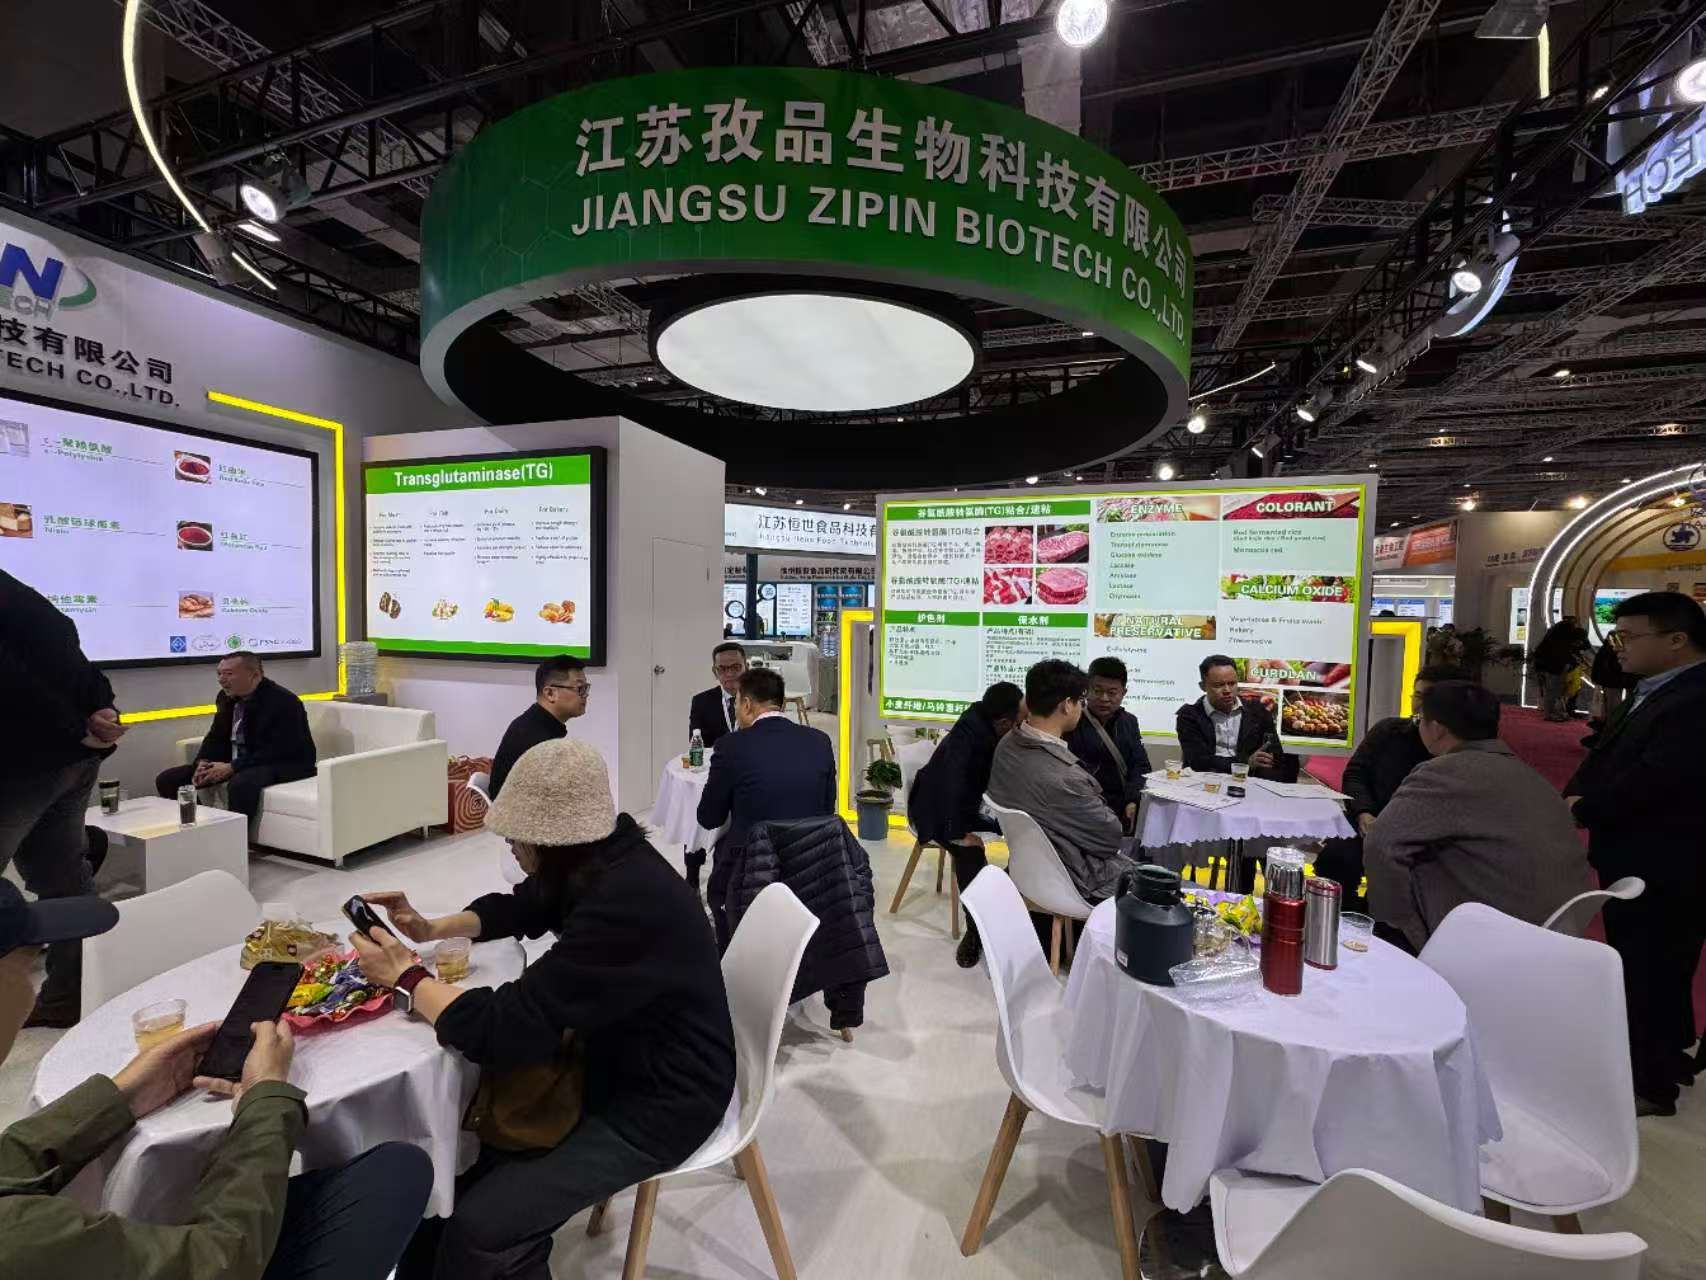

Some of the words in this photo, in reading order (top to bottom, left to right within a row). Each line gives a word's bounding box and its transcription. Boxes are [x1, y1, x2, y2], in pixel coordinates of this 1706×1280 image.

[574, 98, 1187, 299] 江苏孜品生物科技有限公司
[571, 183, 787, 236] JIANGSU
[807, 186, 937, 237] ZIPIN
[956, 206, 1113, 290] BIOTECH
[0, 350, 65, 380] ECH
[76, 368, 181, 408] CO.,LTD.
[394, 462, 554, 488] Transglutaminase(TG)
[1130, 503, 1185, 514] ENZYME
[1256, 500, 1334, 513] COLORANT
[1240, 584, 1299, 595] CALCIUM
[1302, 585, 1344, 597] OXIDE
[1125, 615, 1185, 626] NATURAL
[1110, 626, 1202, 638] PRESERVATIVE
[1250, 666, 1318, 681] CURDLAN
